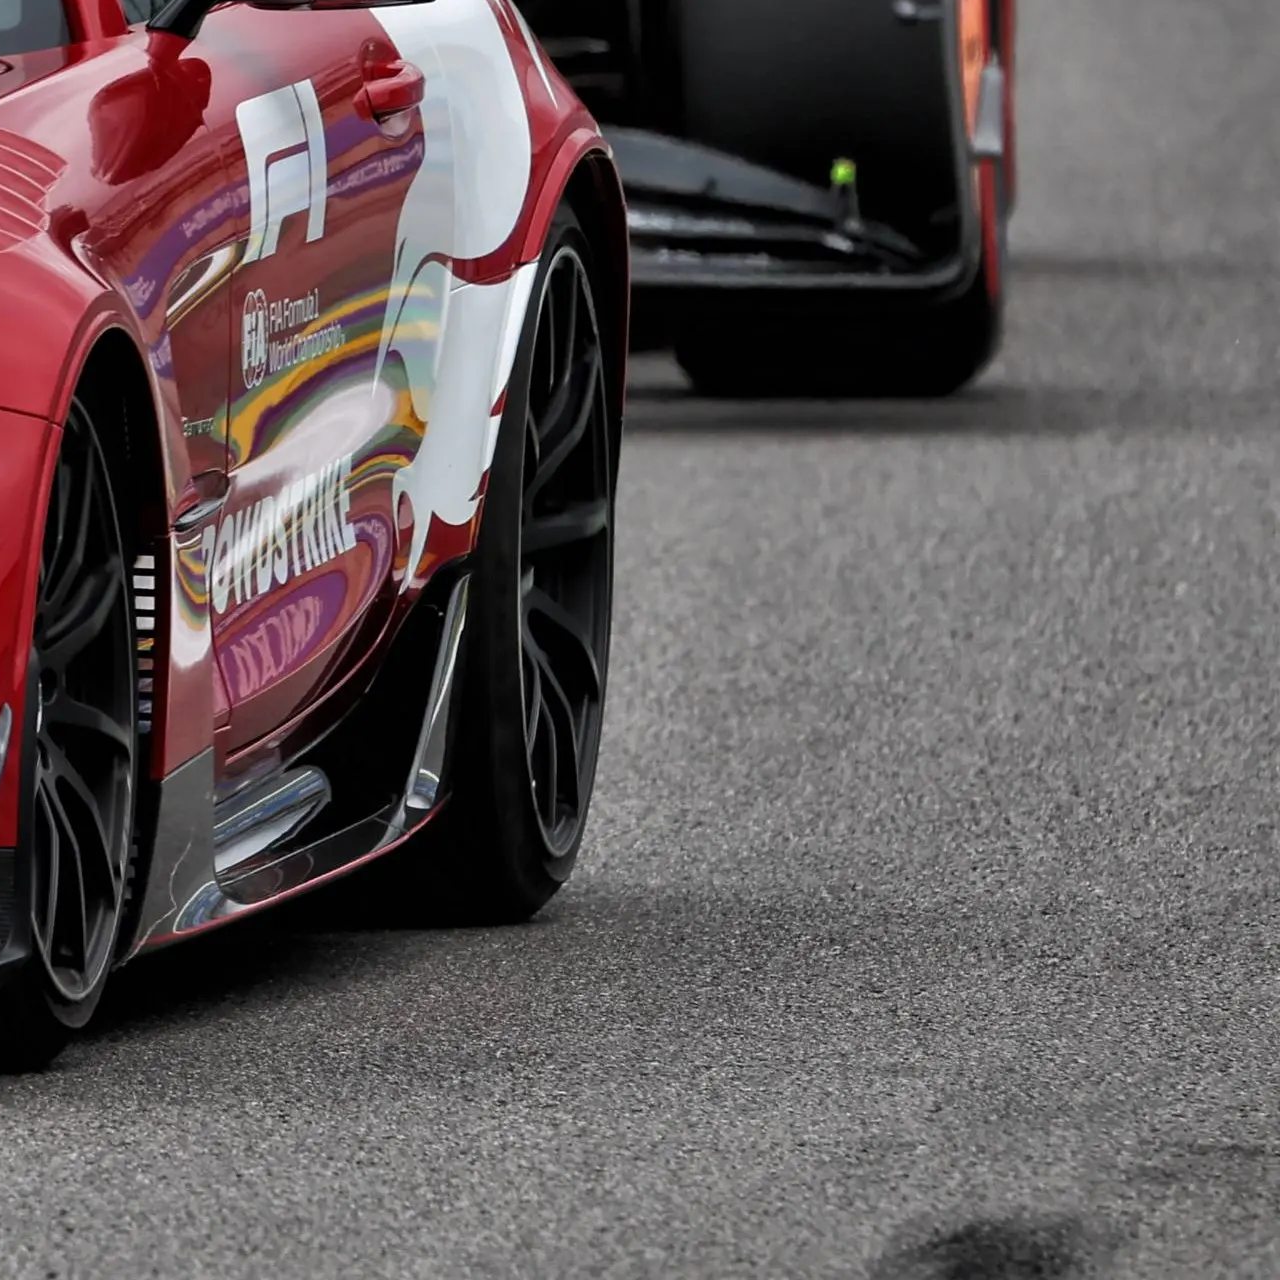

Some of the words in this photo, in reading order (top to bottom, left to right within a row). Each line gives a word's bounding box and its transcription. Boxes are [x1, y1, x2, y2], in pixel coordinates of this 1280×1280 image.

[268, 300, 284, 334] FIA
[282, 289, 315, 328] Formula
[268, 334, 294, 373] World
[292, 319, 344, 364] Championship
